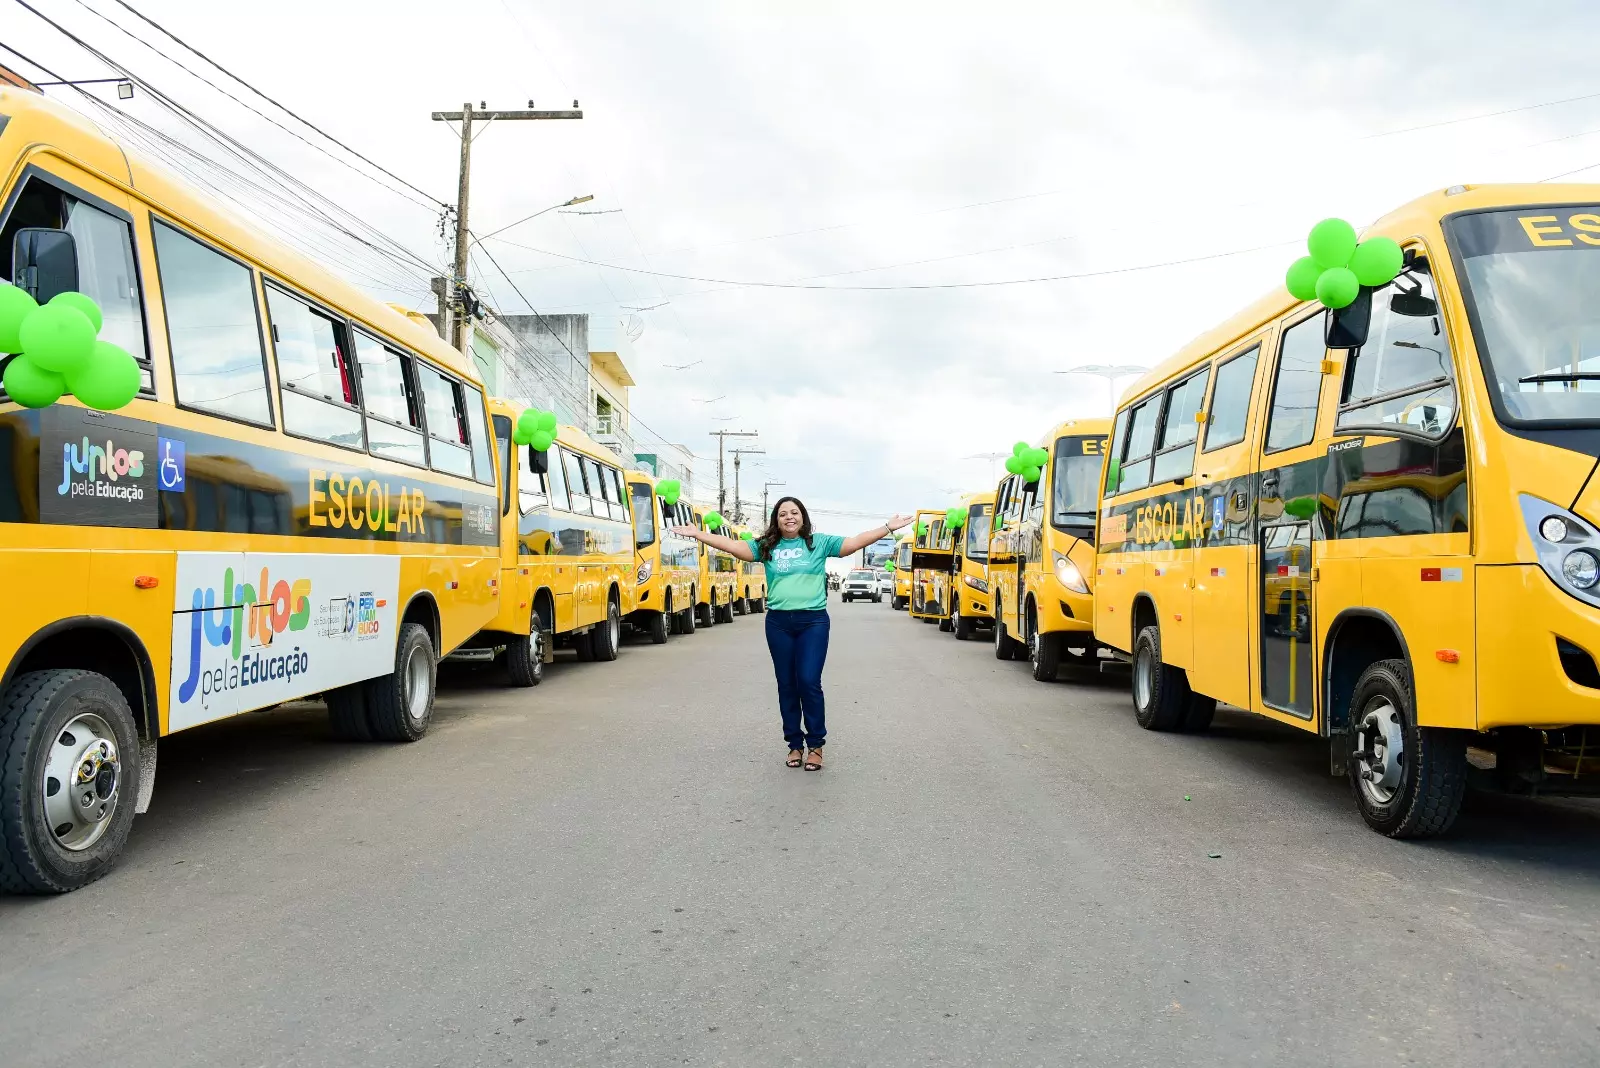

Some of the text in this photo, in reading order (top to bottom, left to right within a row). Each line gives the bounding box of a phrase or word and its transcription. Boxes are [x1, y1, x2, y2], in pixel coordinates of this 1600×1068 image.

[1328, 439, 1362, 452] THUNDER
[71, 480, 144, 502] pela Educação
[309, 467, 425, 535] ESCOLAR
[1136, 495, 1205, 544] ESCOLAR
[201, 646, 308, 705] pela Educação
